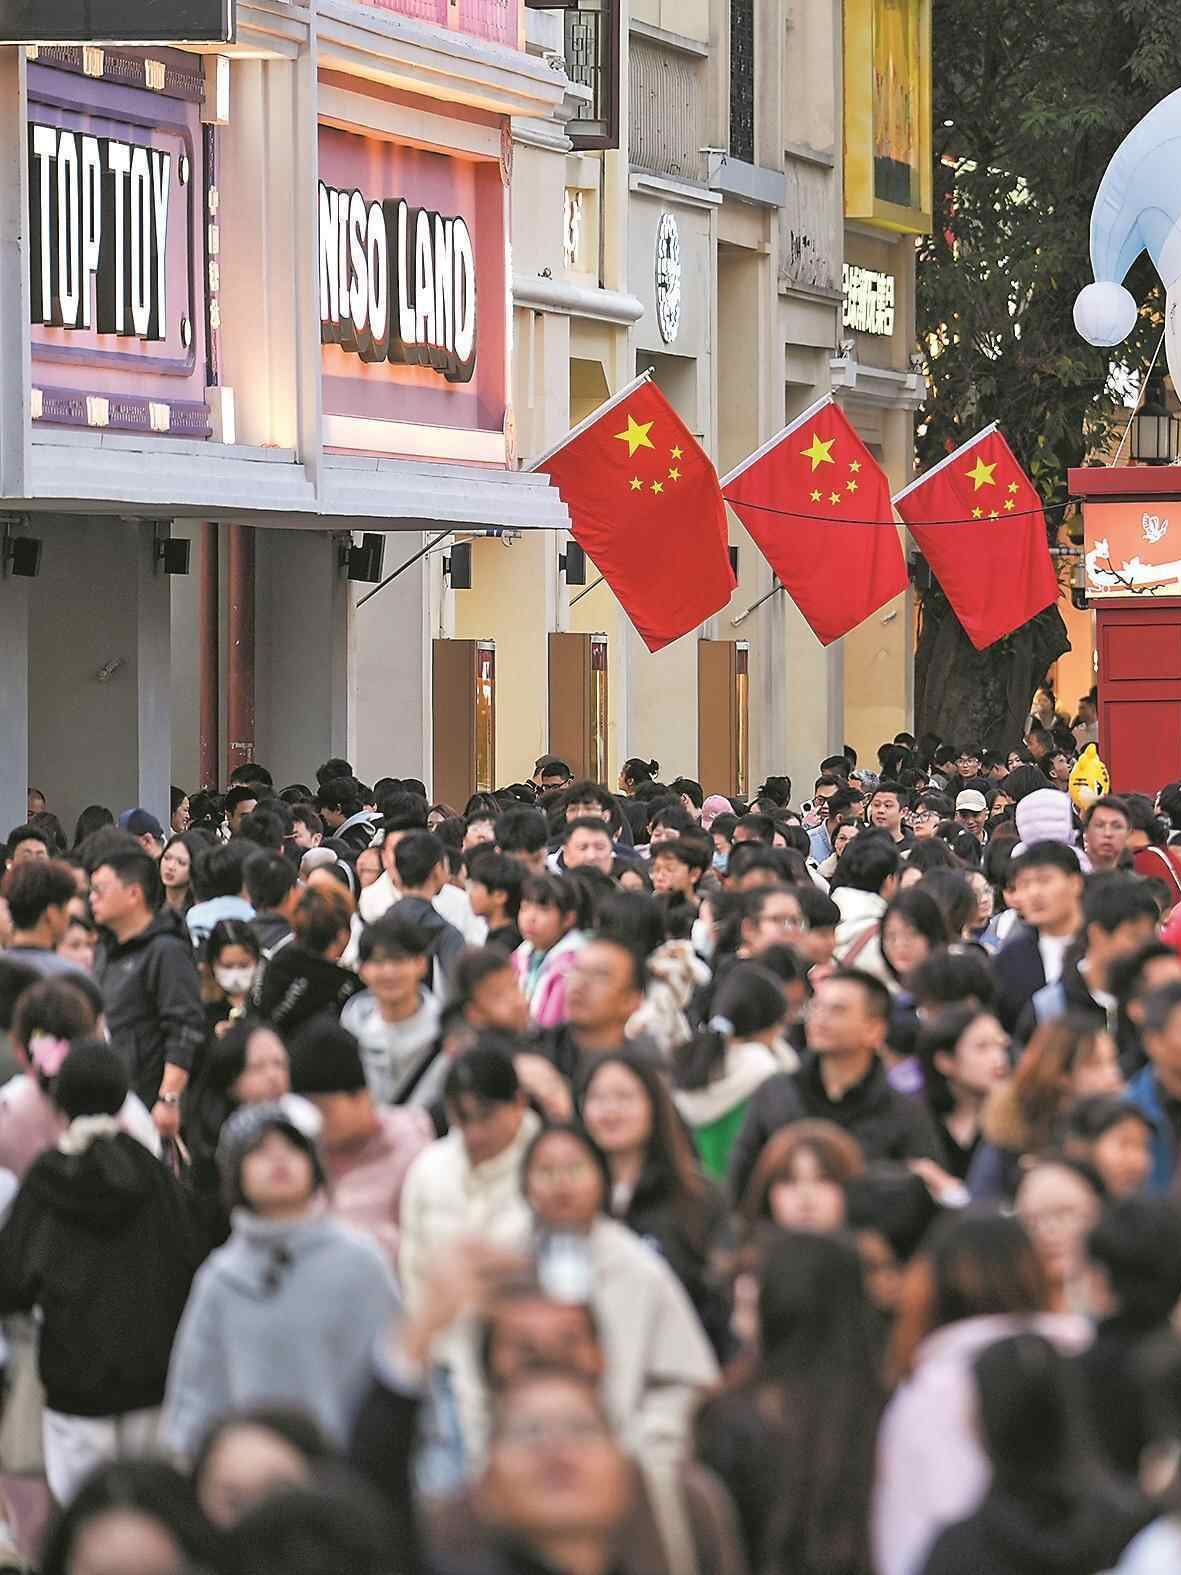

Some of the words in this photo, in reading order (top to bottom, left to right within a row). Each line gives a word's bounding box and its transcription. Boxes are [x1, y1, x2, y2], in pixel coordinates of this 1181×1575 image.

[32, 122, 101, 330] TOP
[107, 139, 171, 340] TOY
[396, 198, 476, 365] LAND
